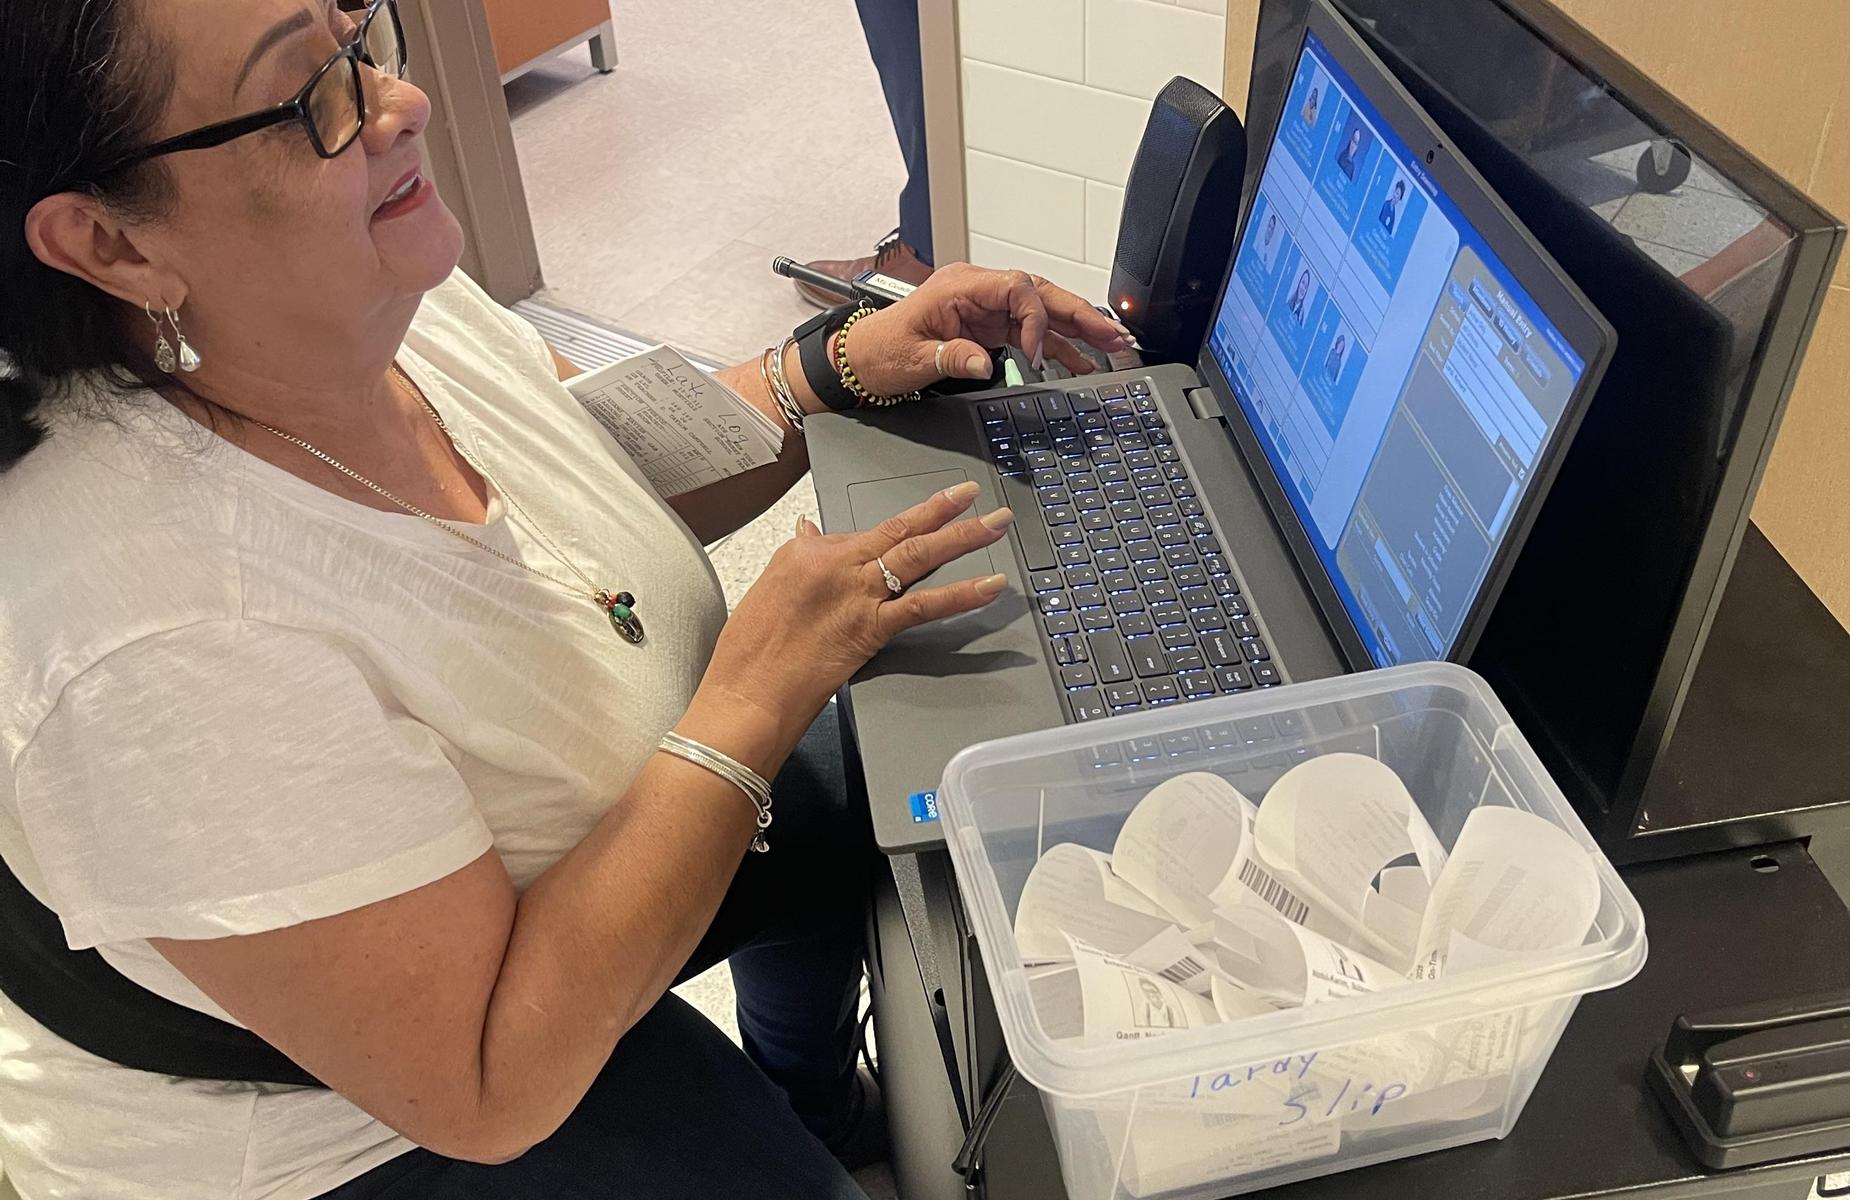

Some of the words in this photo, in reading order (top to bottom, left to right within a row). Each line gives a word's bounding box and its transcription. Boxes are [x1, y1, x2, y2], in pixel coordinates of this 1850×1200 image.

[1495, 289, 1518, 320] Manual
[1514, 313, 1533, 340] Entry
[667, 364, 705, 398] Late
[717, 413, 749, 447] Log
